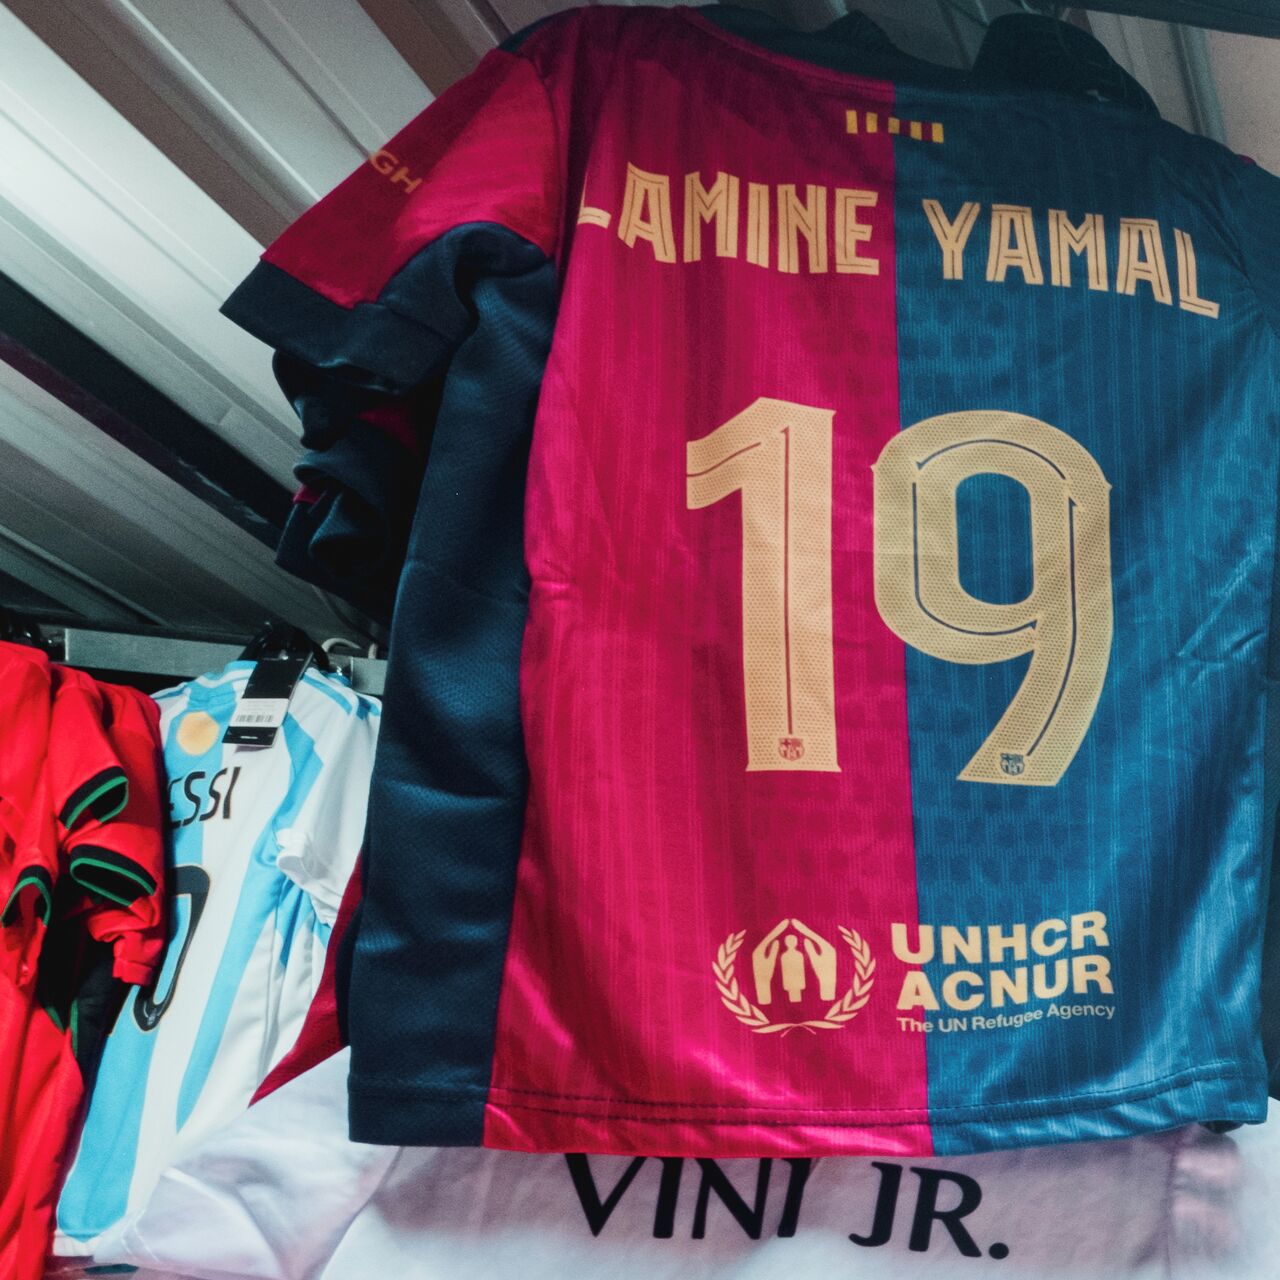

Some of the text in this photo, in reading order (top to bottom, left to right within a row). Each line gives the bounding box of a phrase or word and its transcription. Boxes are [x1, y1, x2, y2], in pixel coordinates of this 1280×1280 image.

[921, 198, 1220, 319] YAMAL
[685, 397, 1112, 787] 19
[890, 910, 1110, 965] UNHCR
[896, 954, 1115, 1011] ACNUR
[896, 1001, 1117, 1034] The UN Refugee Agency
[563, 1153, 1010, 1260] VINI JR.
